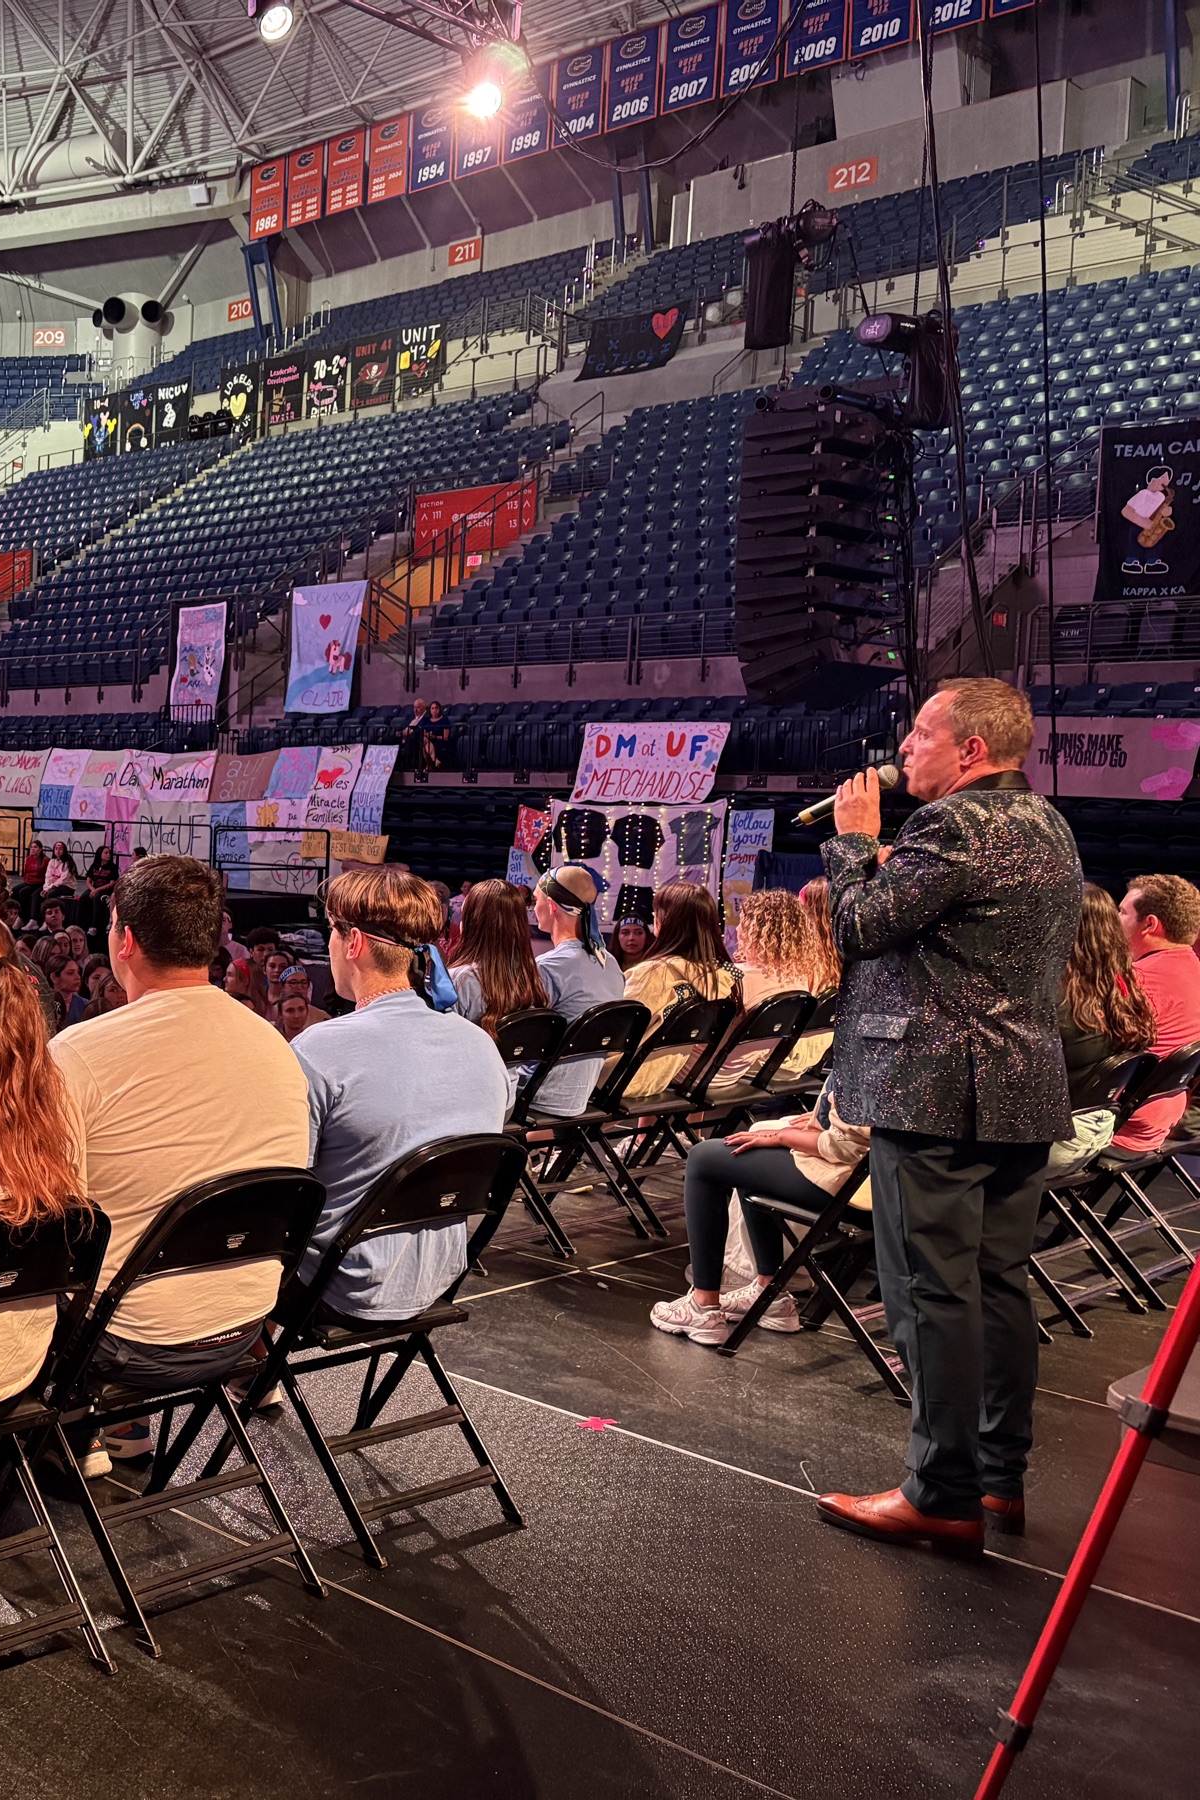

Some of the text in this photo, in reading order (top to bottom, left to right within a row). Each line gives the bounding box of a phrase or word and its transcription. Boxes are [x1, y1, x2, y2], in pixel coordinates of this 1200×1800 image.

[732, 17, 772, 35] GYMNASTICS
[859, 18, 902, 47] 2010
[673, 36, 710, 53] GYMNASTICS
[793, 36, 837, 66] 2009
[615, 56, 651, 73] GYMNASTICS
[563, 75, 596, 90] GYMNASTICS
[668, 77, 708, 104] 2007
[512, 94, 542, 107] GYMNASTIC
[611, 96, 649, 122] 2006
[418, 126, 447, 140] GYMNASTICS
[559, 113, 595, 138] 2004
[510, 131, 540, 153] 1998
[463, 146, 492, 169] 1997
[417, 161, 445, 183] 1994
[834, 161, 872, 189] 212
[255, 214, 278, 233] 1982
[454, 242, 476, 262] 211
[229, 304, 252, 319] 210
[35, 330, 65, 345] 209
[402, 324, 441, 345] UNIT
[356, 343, 377, 357] UNIT
[410, 345, 426, 360] 42
[269, 365, 298, 377] Leadership
[314, 355, 340, 380] 10-2
[267, 374, 299, 386] Development
[158, 386, 181, 400] NICU
[1114, 443, 1163, 458] TEAM
[420, 501, 444, 509] SECTION
[507, 501, 518, 510] 113
[433, 510, 442, 519] 111
[509, 520, 518, 528] 13
[432, 529, 438, 538] 11
[1123, 587, 1157, 596] KAPPA
[1169, 585, 1186, 595] KA
[642, 739, 656, 757] at
[1049, 733, 1124, 751] MINIS MAKE
[1063, 750, 1108, 767] WORLD
[1109, 751, 1128, 768] GO
[5, 774, 36, 795] LIVES
[150, 766, 209, 790] Marathon
[314, 776, 349, 790] Loves
[585, 768, 713, 801] MERCHANDISE
[56, 788, 70, 806] THE
[307, 794, 346, 808] Miracle
[357, 793, 375, 807] UP
[305, 808, 343, 824] Families
[352, 808, 379, 823] ALL
[731, 811, 773, 833] follow
[733, 834, 768, 852] your
[510, 862, 521, 872] all
[675, 1311, 682, 1319] N
